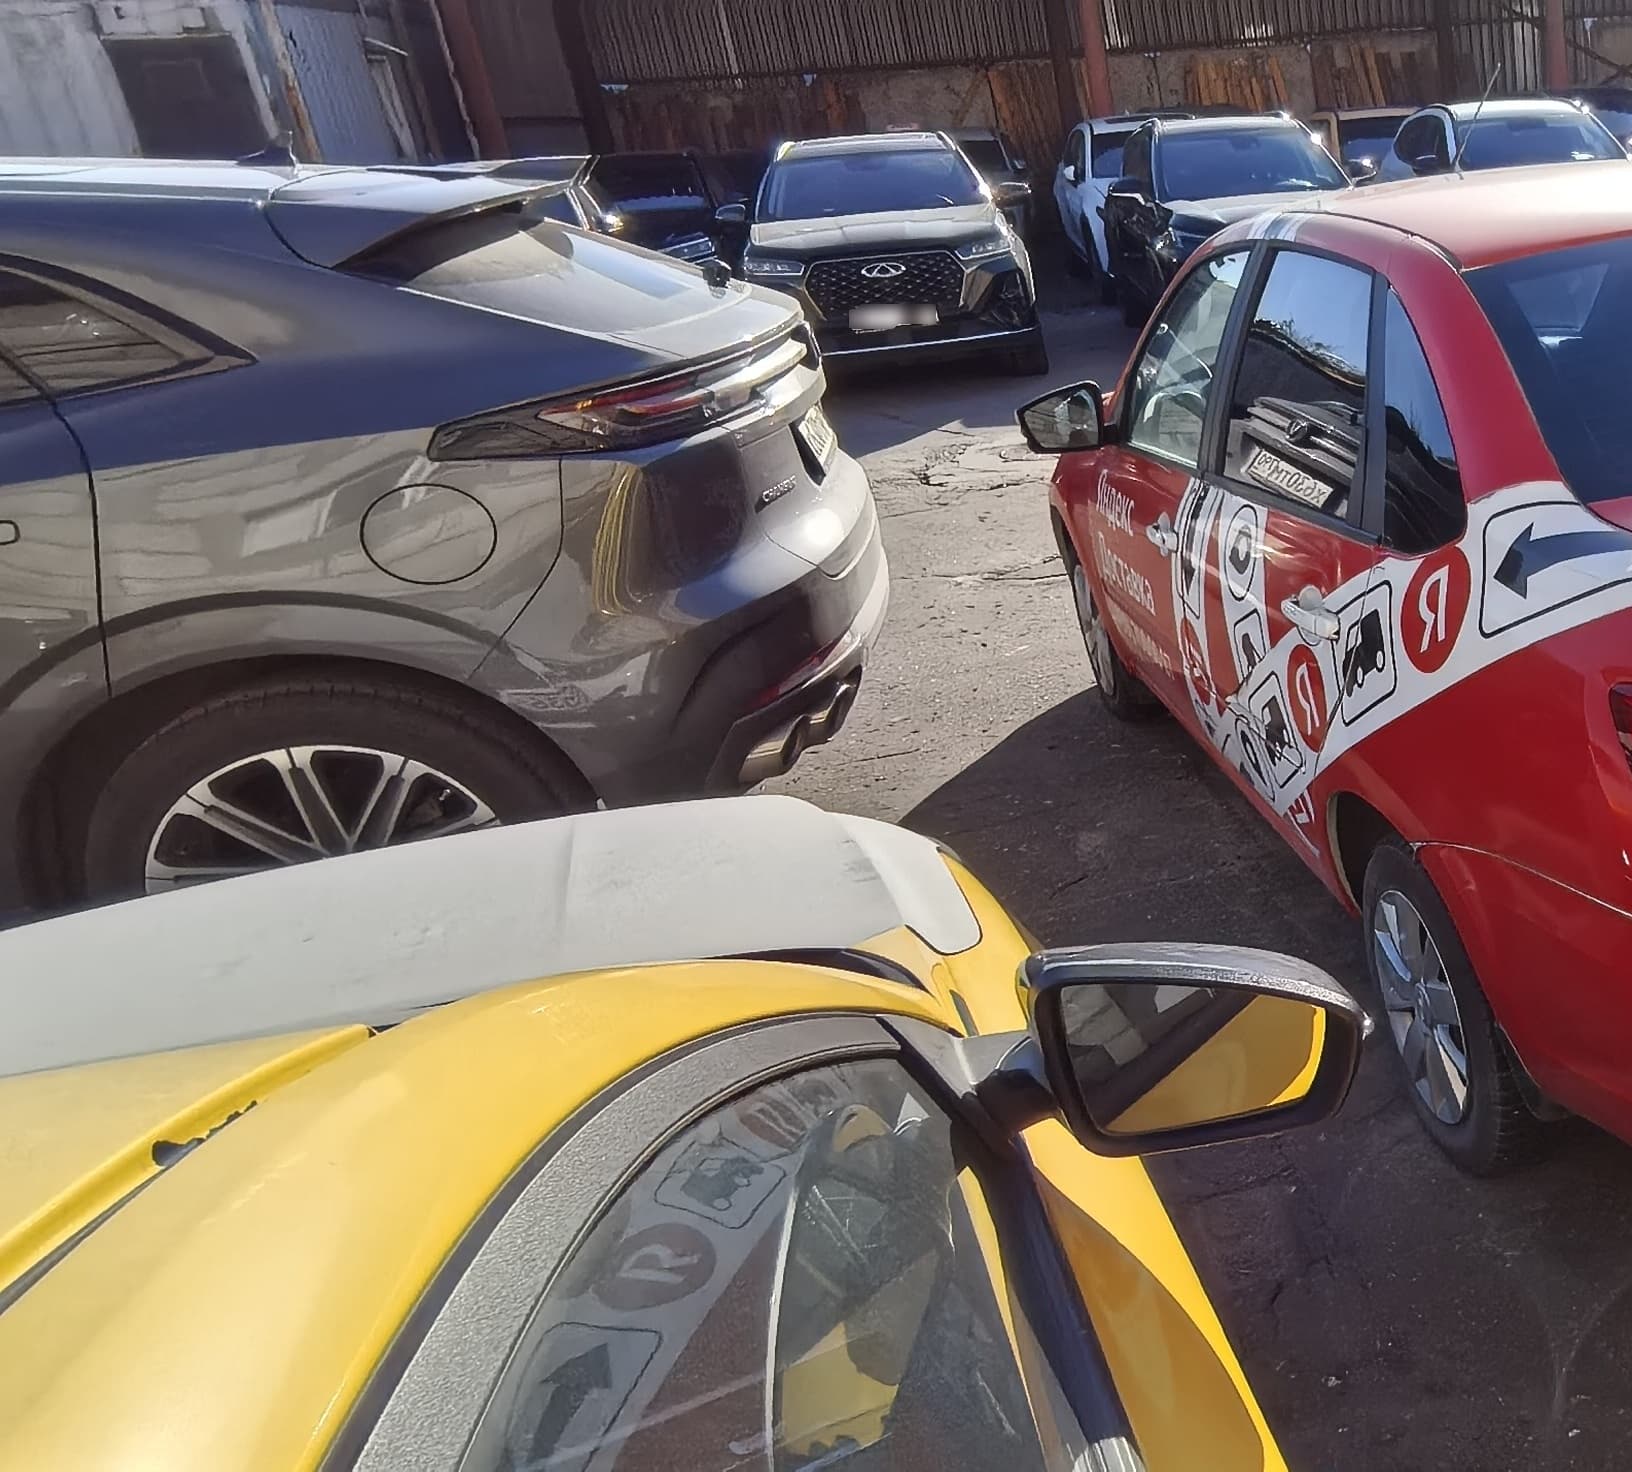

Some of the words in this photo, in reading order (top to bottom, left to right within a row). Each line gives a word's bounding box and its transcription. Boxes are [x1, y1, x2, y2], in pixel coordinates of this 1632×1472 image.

[1096, 468, 1135, 538] Яндекс
[1097, 531, 1156, 617] Доставка
[1418, 563, 1450, 654] Я
[1295, 661, 1320, 736] Я
